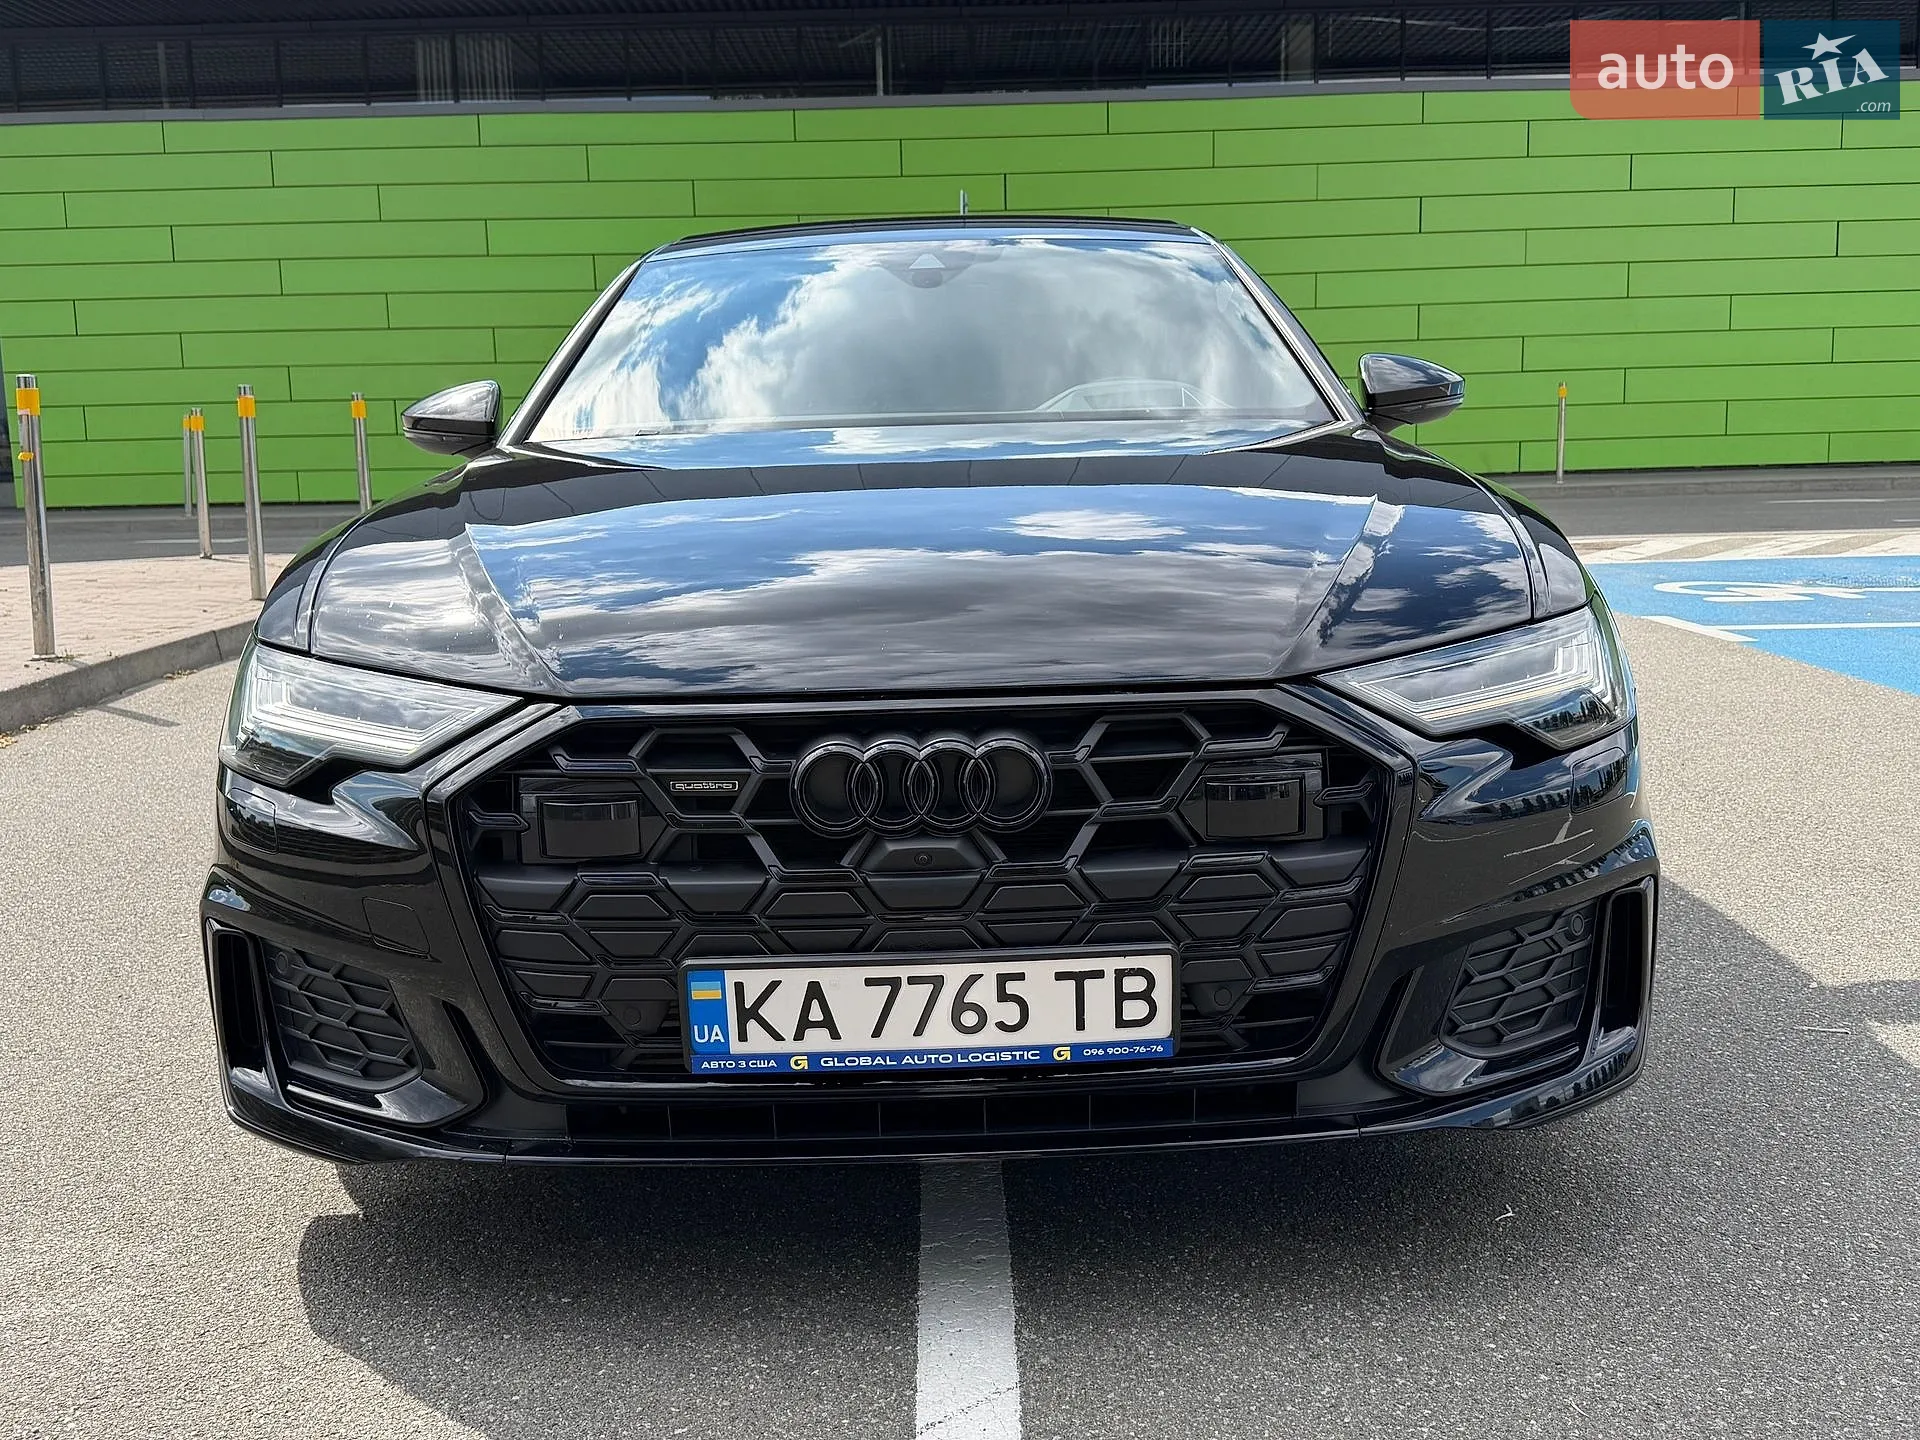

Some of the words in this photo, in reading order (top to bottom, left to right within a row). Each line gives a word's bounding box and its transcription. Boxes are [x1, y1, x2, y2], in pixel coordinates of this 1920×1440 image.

[675, 782, 733, 791] quattro
[733, 980, 842, 1042] KA
[864, 971, 1030, 1039] 7765
[1054, 967, 1158, 1031] TB
[693, 1025, 725, 1043] UA
[1083, 1047, 1105, 1057] 096
[1106, 1045, 1164, 1055] 900-76-76
[701, 1059, 736, 1069] АВТО
[748, 1059, 778, 1068] США
[820, 1054, 898, 1067] GLOBAL
[901, 1053, 952, 1065] AUTO
[957, 1050, 1041, 1063] LOGISTIC
